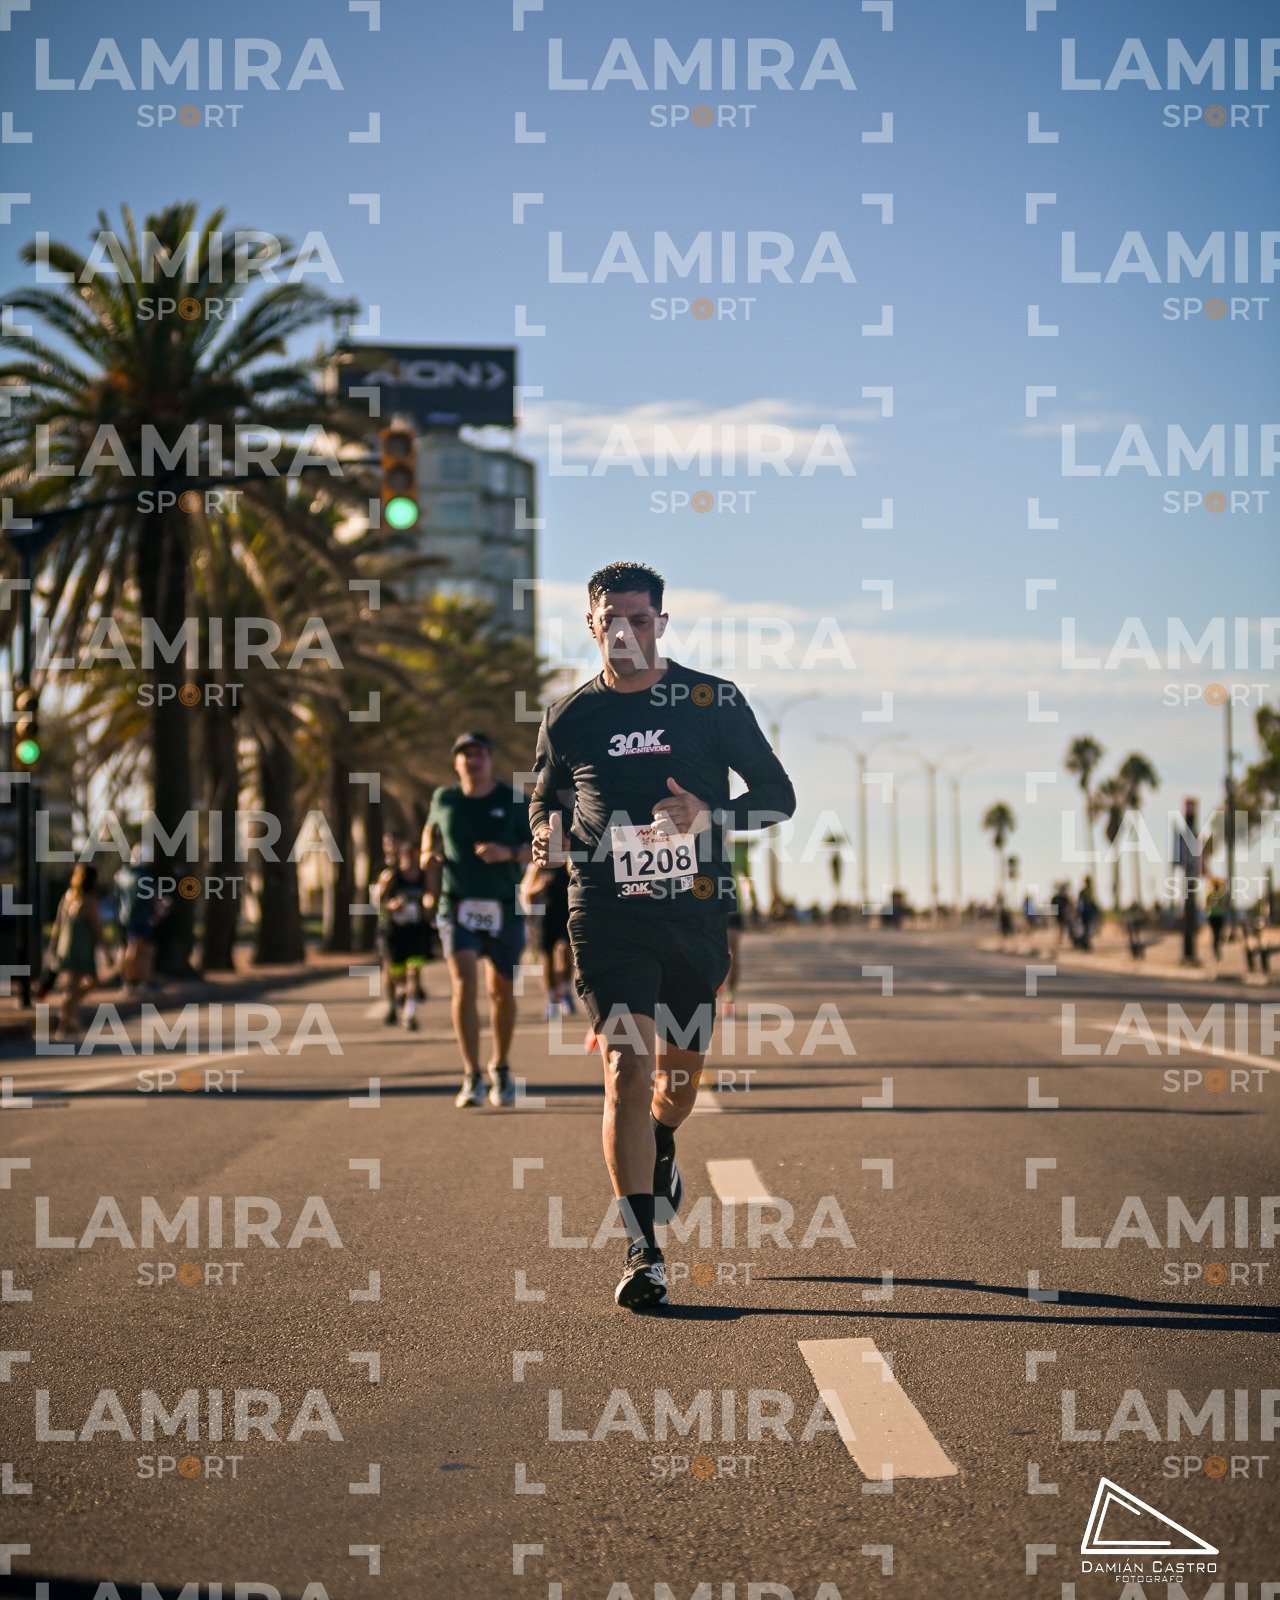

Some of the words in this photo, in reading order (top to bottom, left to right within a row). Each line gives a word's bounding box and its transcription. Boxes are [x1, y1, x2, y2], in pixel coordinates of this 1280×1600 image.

[608, 729, 665, 756] 30K
[620, 845, 691, 876] 1208
[621, 882, 650, 895] 30K
